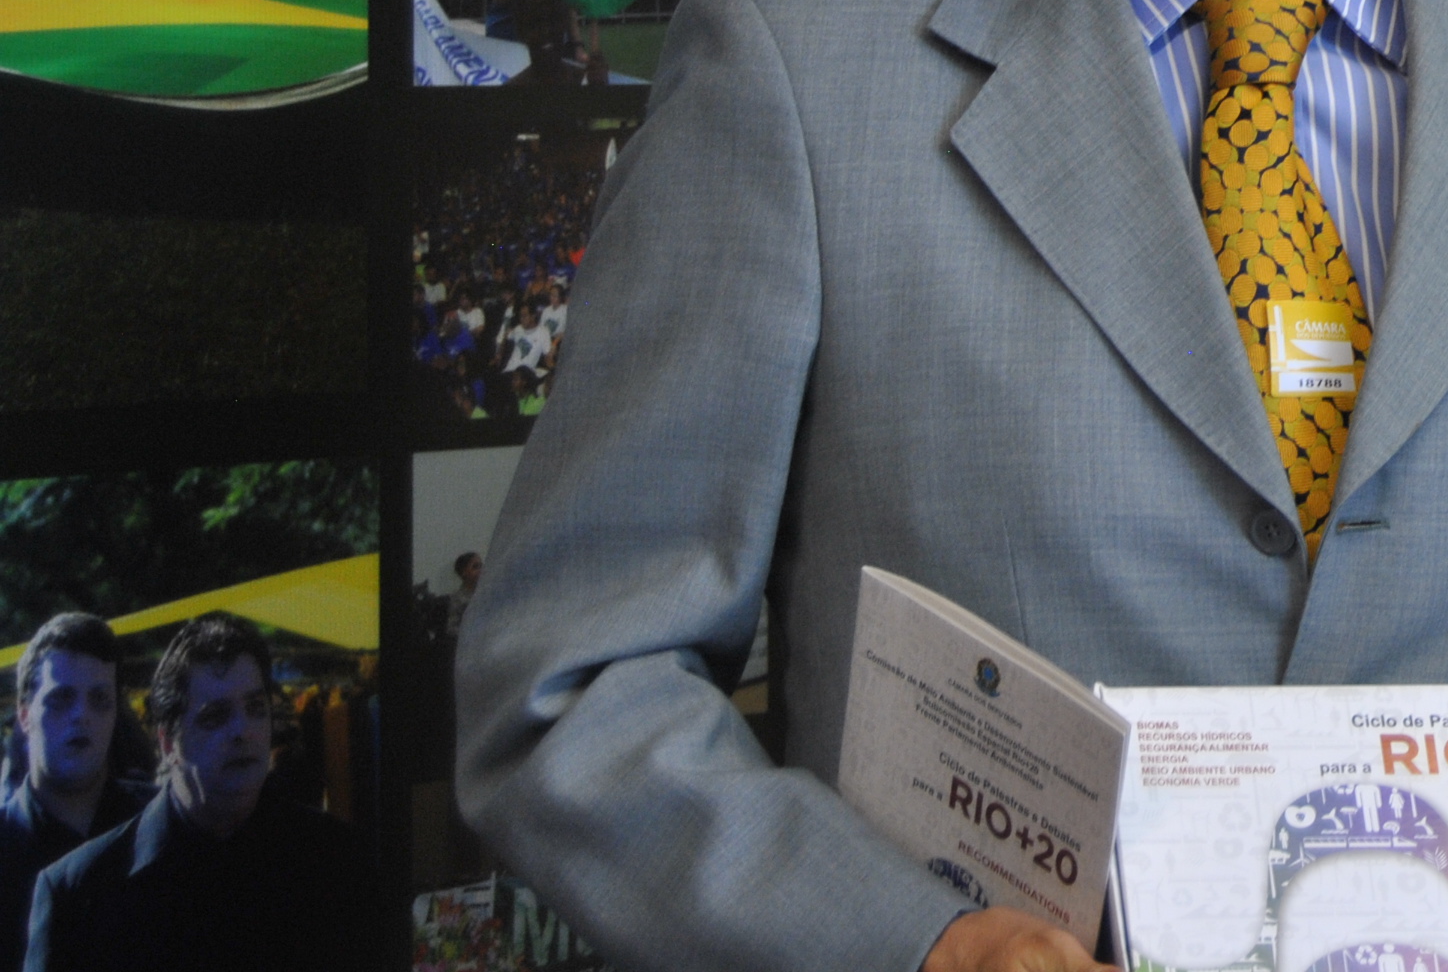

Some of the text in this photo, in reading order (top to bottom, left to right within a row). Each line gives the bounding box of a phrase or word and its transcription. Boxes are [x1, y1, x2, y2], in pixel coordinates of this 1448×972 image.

[1295, 318, 1346, 334] CÂMARA
[1298, 378, 1342, 388] 18788
[866, 649, 906, 680] Comissão
[918, 681, 937, 698] Meio
[939, 694, 976, 723] Ambiente
[984, 721, 1051, 771] Desenvolvimento
[1137, 721, 1179, 730] BIOMAS
[1351, 714, 1397, 728] Ciclo
[1403, 714, 1424, 728] de
[1138, 731, 1252, 741] RECURSOS HÍDRICOS
[1141, 755, 1189, 763] ENERGIA
[1141, 766, 1276, 775] MEIO AMBIENTE URBANO
[1319, 762, 1358, 777] para
[1362, 763, 1372, 774] a
[1143, 778, 1240, 787] ECONOMIA VERDE
[939, 751, 966, 776] Ciclo
[967, 770, 981, 786] de
[983, 779, 1029, 817] Palestras
[1041, 817, 1082, 853] Debates
[912, 777, 935, 797] para
[949, 775, 1078, 886] RIO+20
[958, 839, 1071, 925] RECOMMENDATIONS
